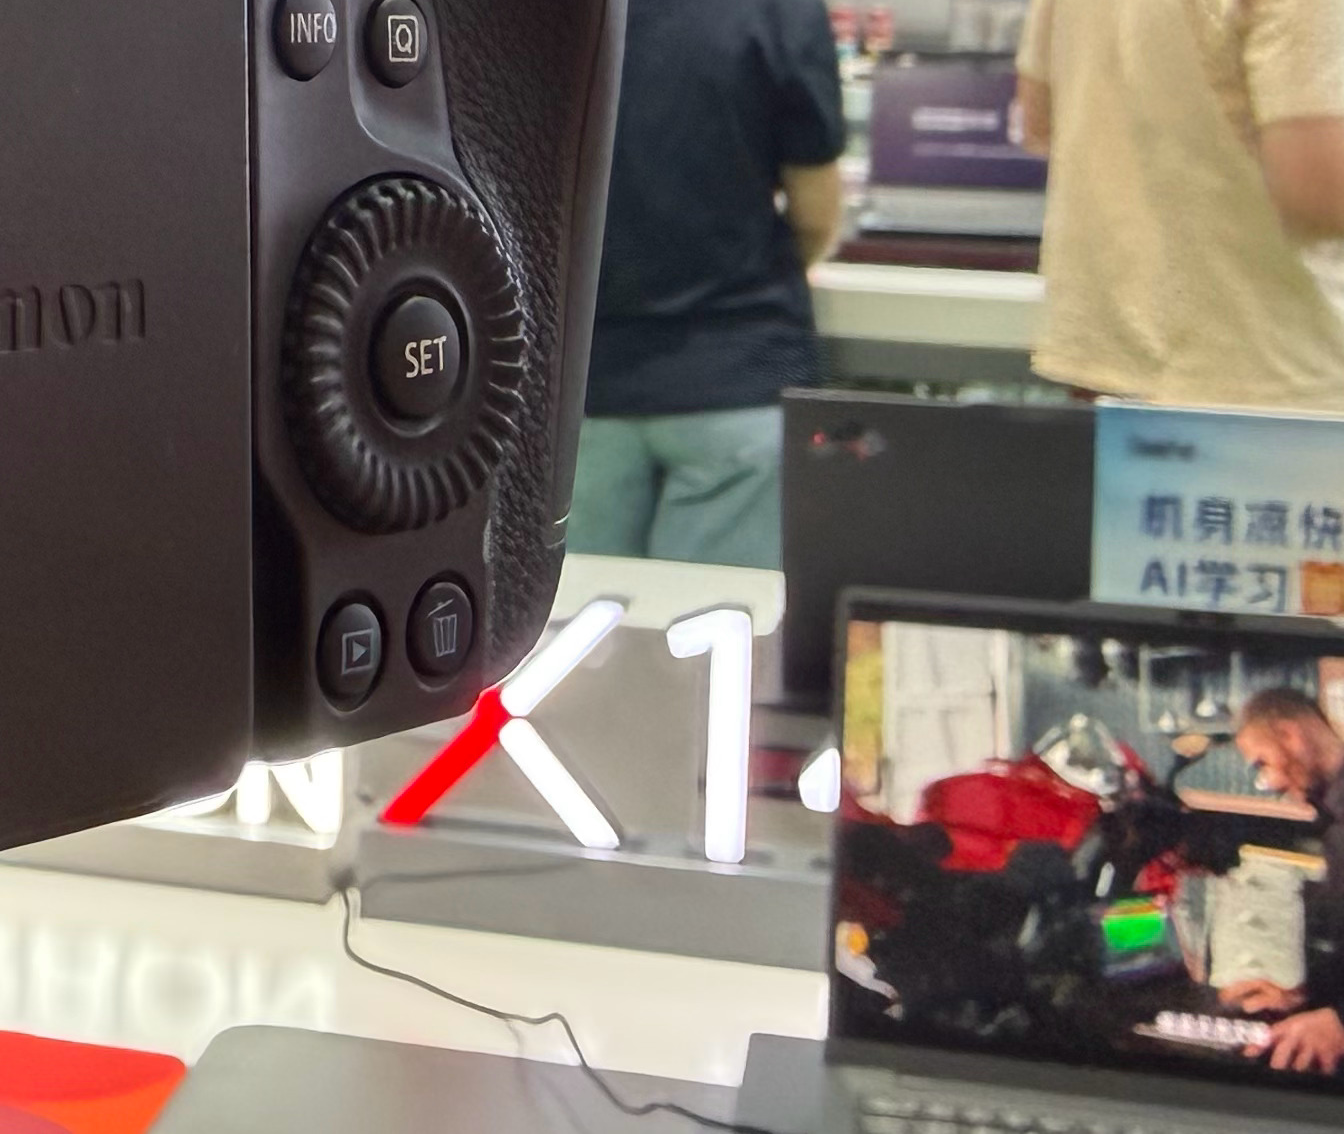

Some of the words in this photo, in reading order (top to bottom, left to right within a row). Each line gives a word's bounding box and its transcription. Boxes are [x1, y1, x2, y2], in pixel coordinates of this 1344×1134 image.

[290, 11, 337, 44] INFO
[404, 335, 448, 379] SET
[378, 598, 843, 865] X1
